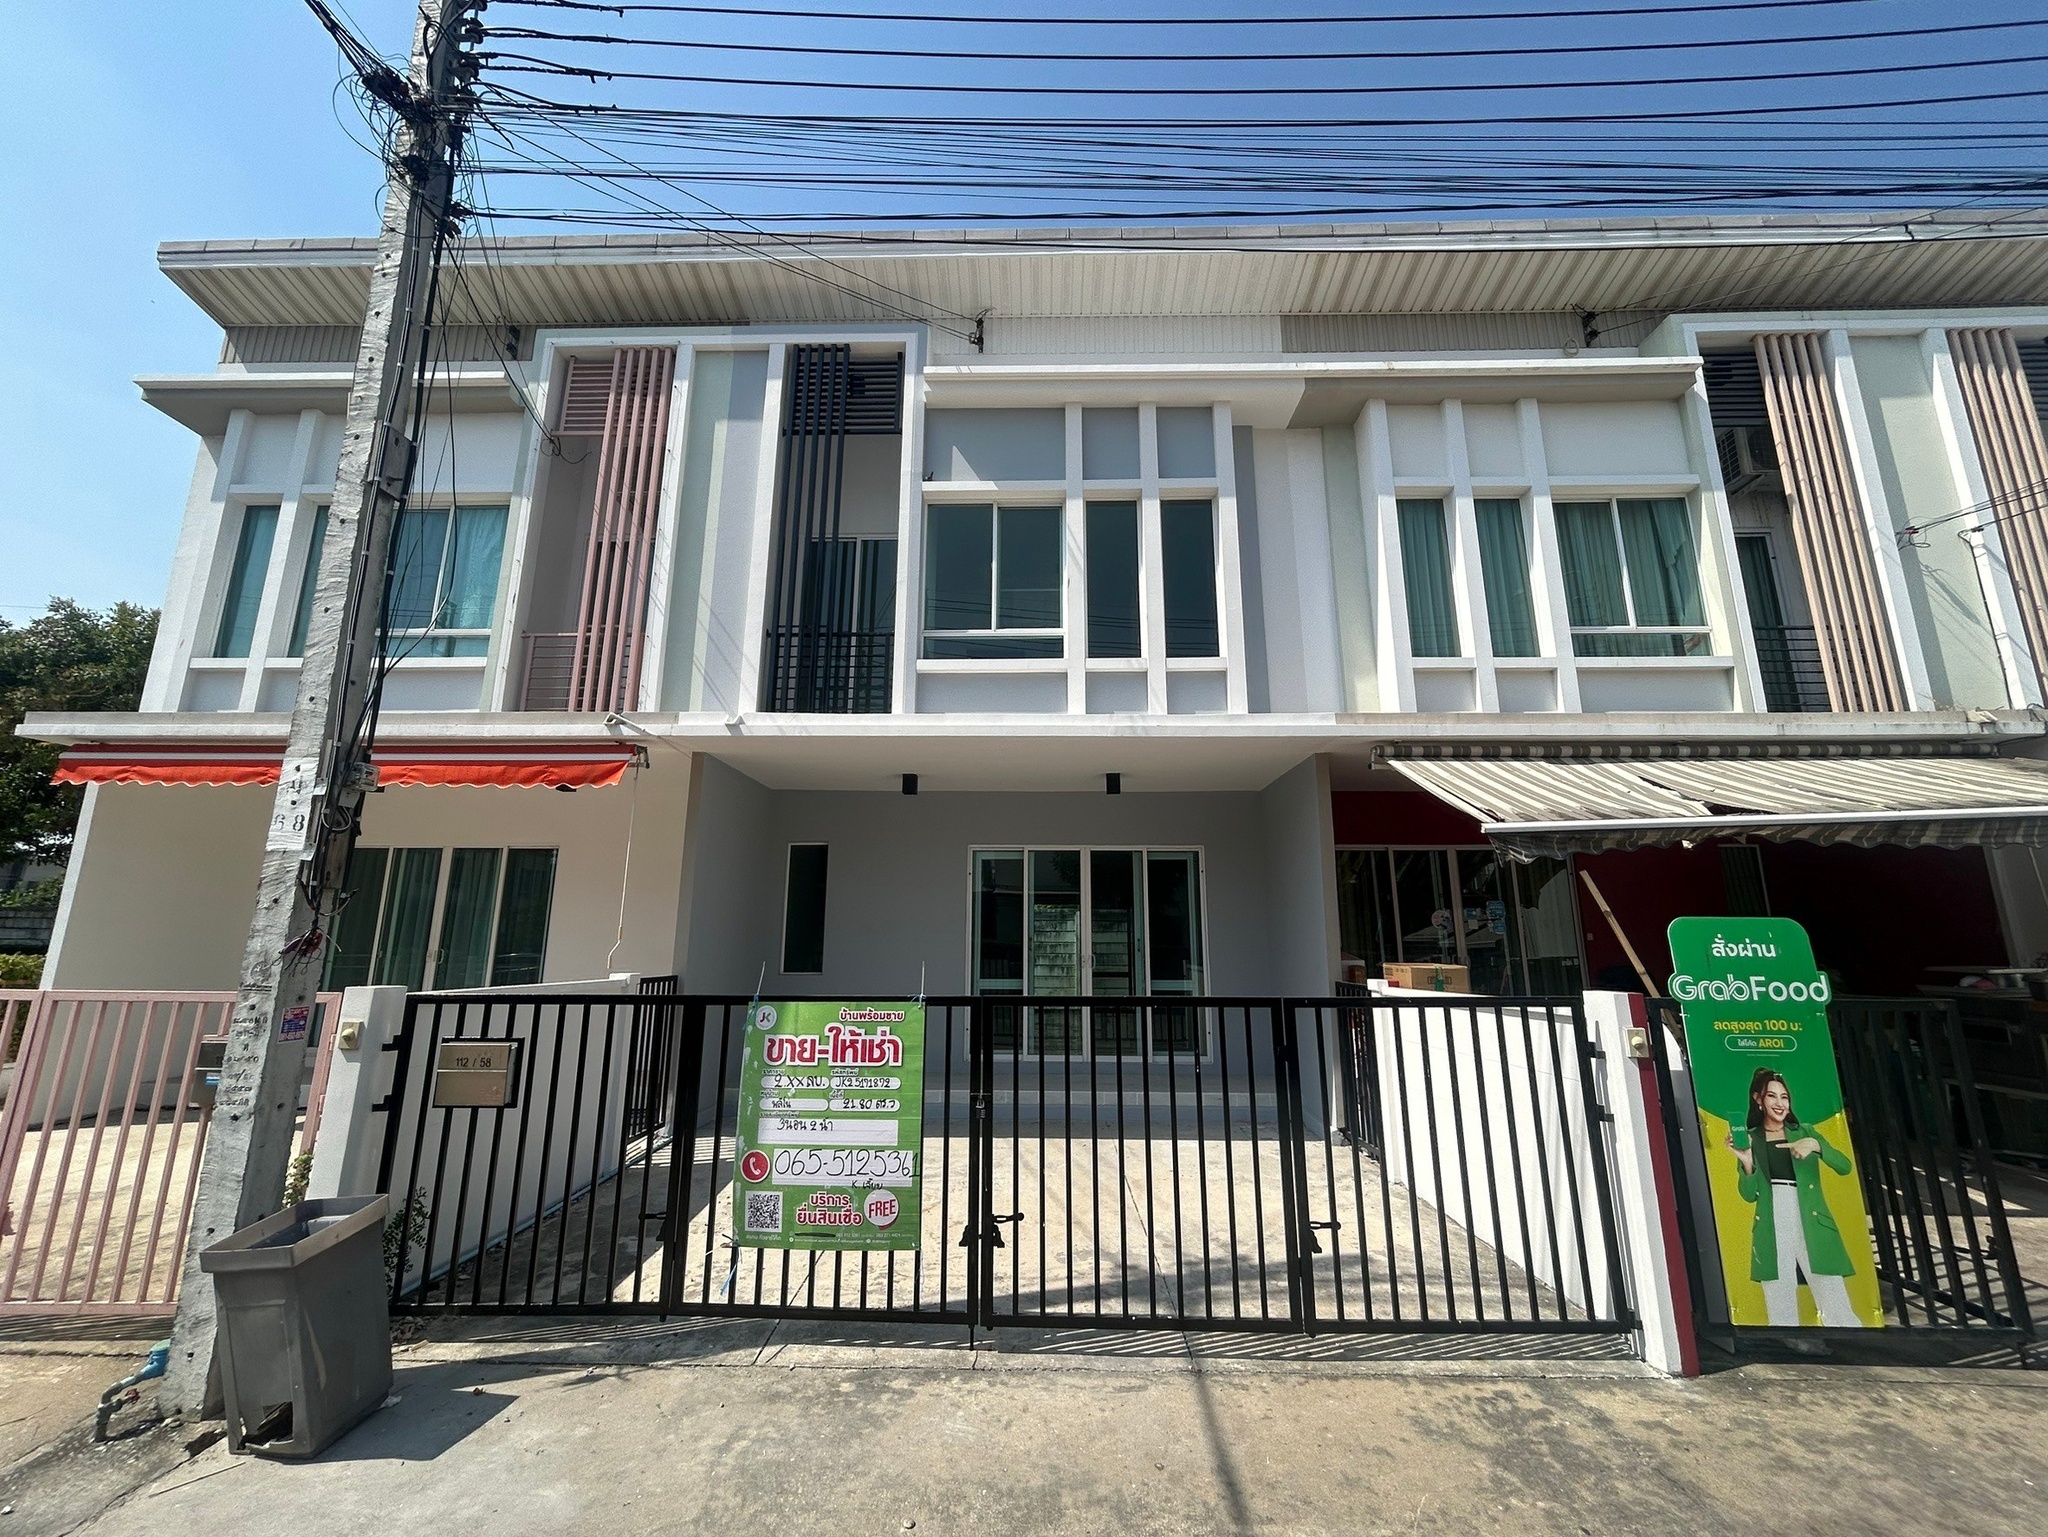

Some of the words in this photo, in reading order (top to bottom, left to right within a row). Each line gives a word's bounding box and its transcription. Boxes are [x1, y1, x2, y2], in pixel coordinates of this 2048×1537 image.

[1711, 933, 1777, 958] สั่งผ่าน
[1672, 973, 1829, 1002] GrabFood
[760, 1012, 771, 1023] JK
[840, 1008, 904, 1021] บ้านพร้อมขาย
[1713, 1020, 1763, 1033] ลดสูงสุด
[1765, 1019, 1787, 1031] 100
[766, 1025, 901, 1064] ขาย-ให้เช่า
[1759, 1038, 1784, 1048] AROI
[456, 1057, 469, 1068] 112
[479, 1057, 492, 1068] 58
[774, 1148, 921, 1178] 065-5125361
[810, 1193, 849, 1206] บริการ
[868, 1198, 896, 1218] FREE
[796, 1203, 863, 1225] ยื่นสินเชื่อ
